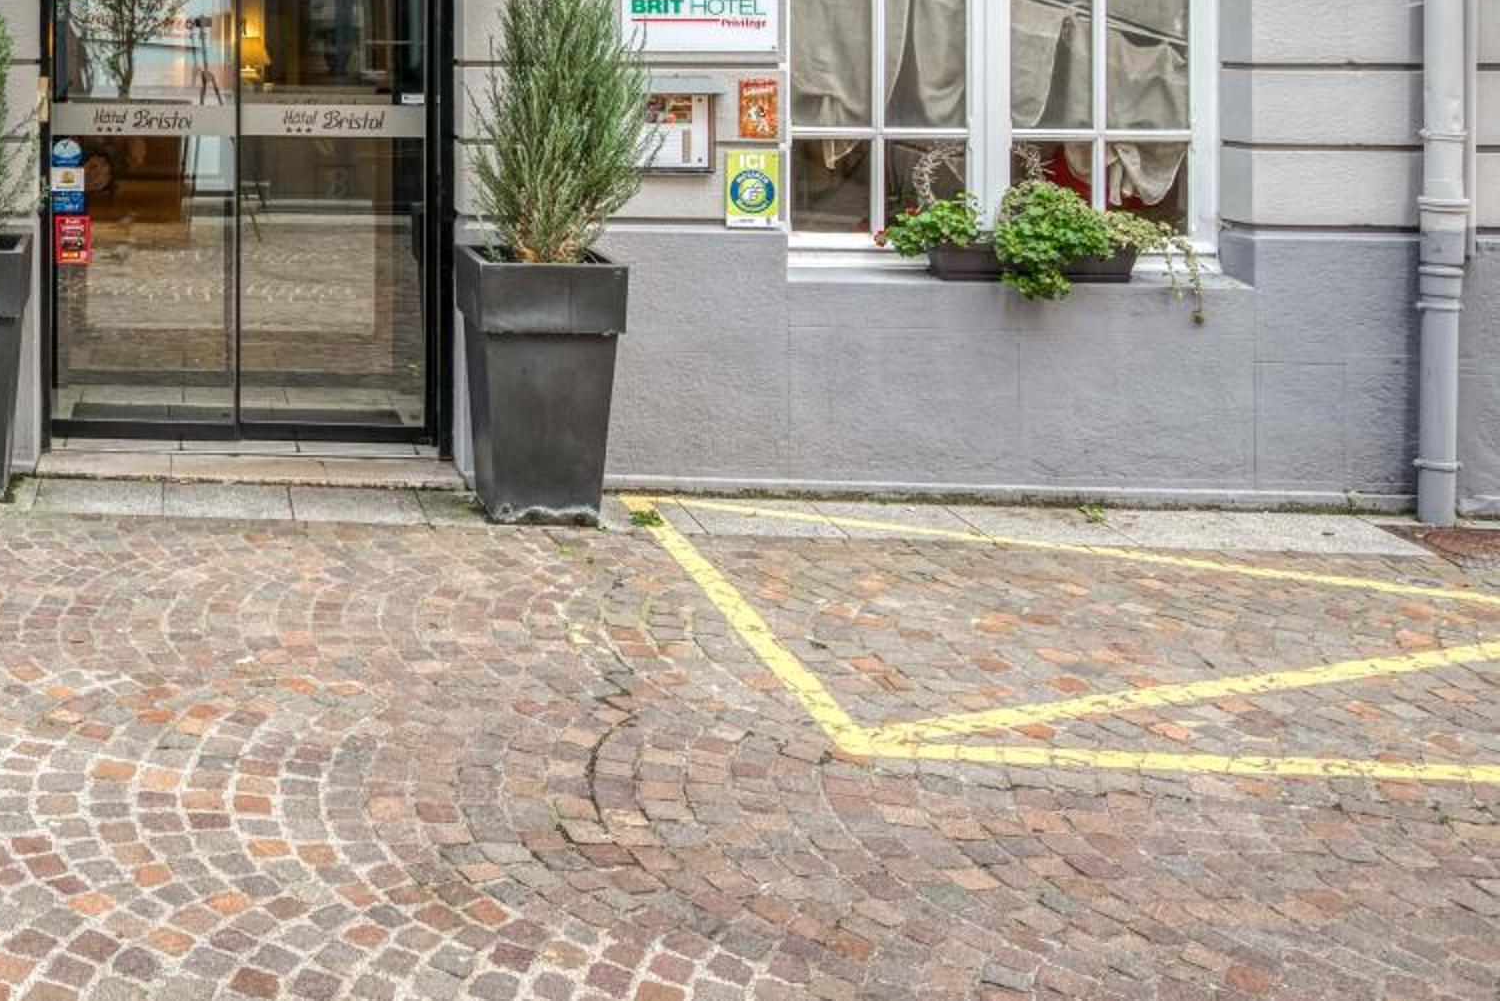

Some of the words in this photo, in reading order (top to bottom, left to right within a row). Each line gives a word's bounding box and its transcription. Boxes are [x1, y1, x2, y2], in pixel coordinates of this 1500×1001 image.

[132, 109, 193, 130] Bristol
[322, 109, 385, 130] Bristol
[739, 154, 765, 168] ICI
